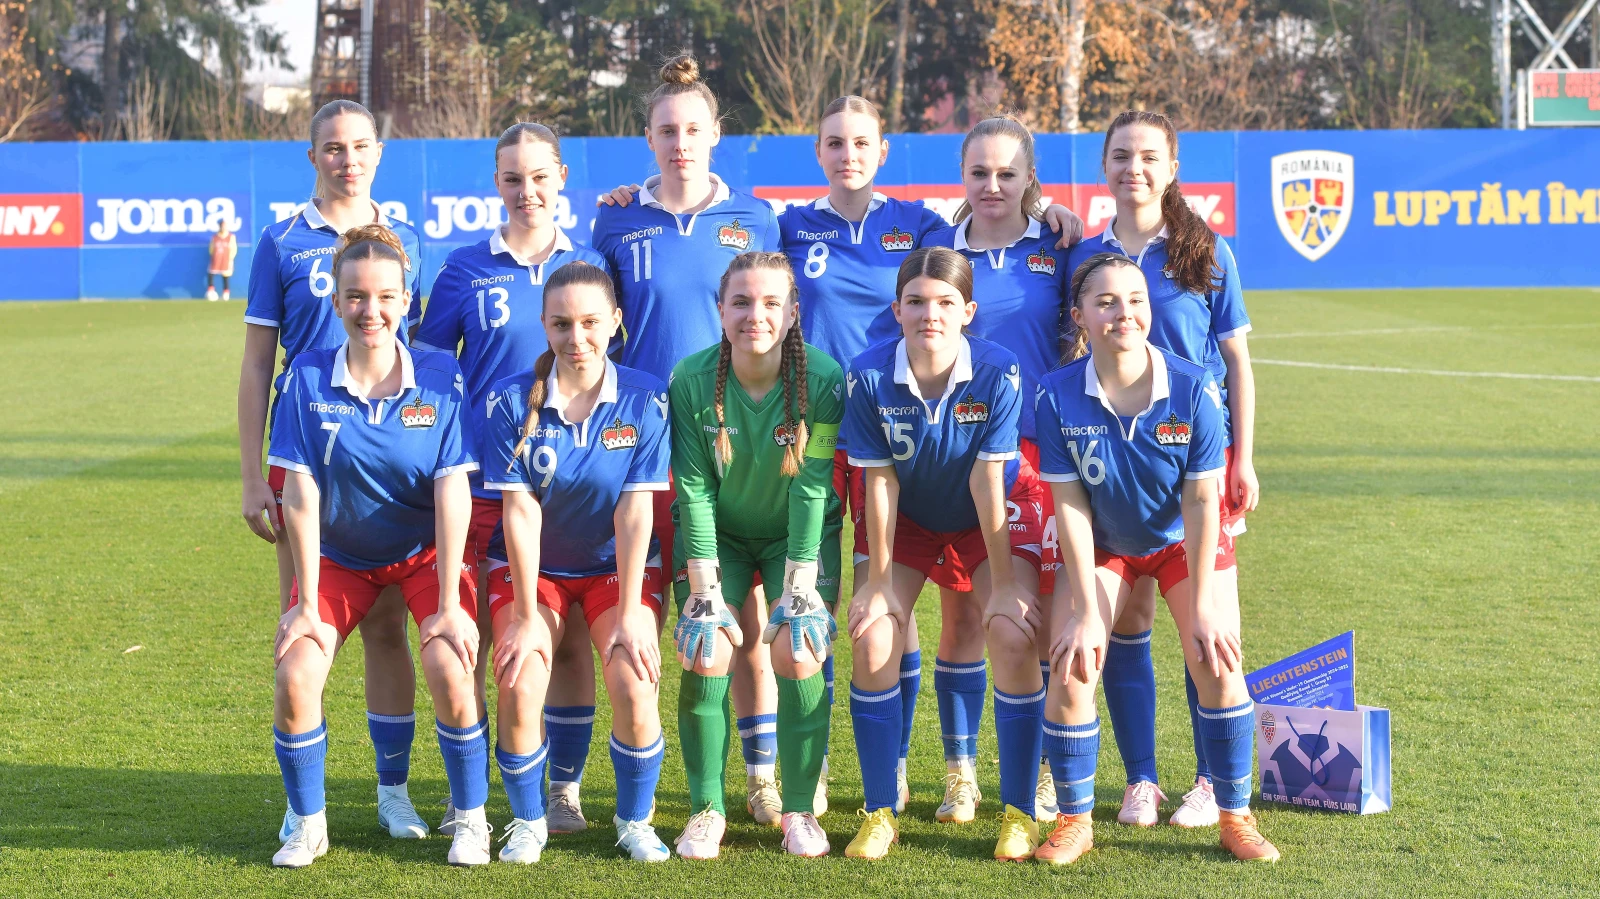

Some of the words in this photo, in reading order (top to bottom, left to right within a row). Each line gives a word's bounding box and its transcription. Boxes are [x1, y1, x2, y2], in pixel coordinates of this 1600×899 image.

[0, 205, 65, 236] NY.
[1373, 182, 1541, 226] LUPTĂM
[1546, 182, 1600, 224] ÎM
[622, 225, 663, 243] macron
[797, 229, 839, 241] macron
[291, 246, 337, 264] macron
[630, 238, 652, 283] 11
[803, 241, 830, 279] 8
[309, 258, 334, 298] 6
[471, 274, 515, 289] macron
[476, 287, 511, 332] 13
[309, 401, 356, 416] macron
[877, 405, 919, 416] macron
[320, 421, 342, 466] 7
[881, 422, 916, 461] 15
[1061, 424, 1108, 437] macron
[522, 444, 558, 488] 19
[1067, 440, 1106, 486] 16
[1251, 647, 1348, 695] LIECHTENSTEIN
[1262, 792, 1272, 801] EIN
[1273, 794, 1291, 803] SPIEL.
[1292, 796, 1303, 805] EIN
[1303, 797, 1322, 808] TEAM.
[1323, 798, 1339, 809] FÜRS
[1340, 802, 1358, 812] LAND.
